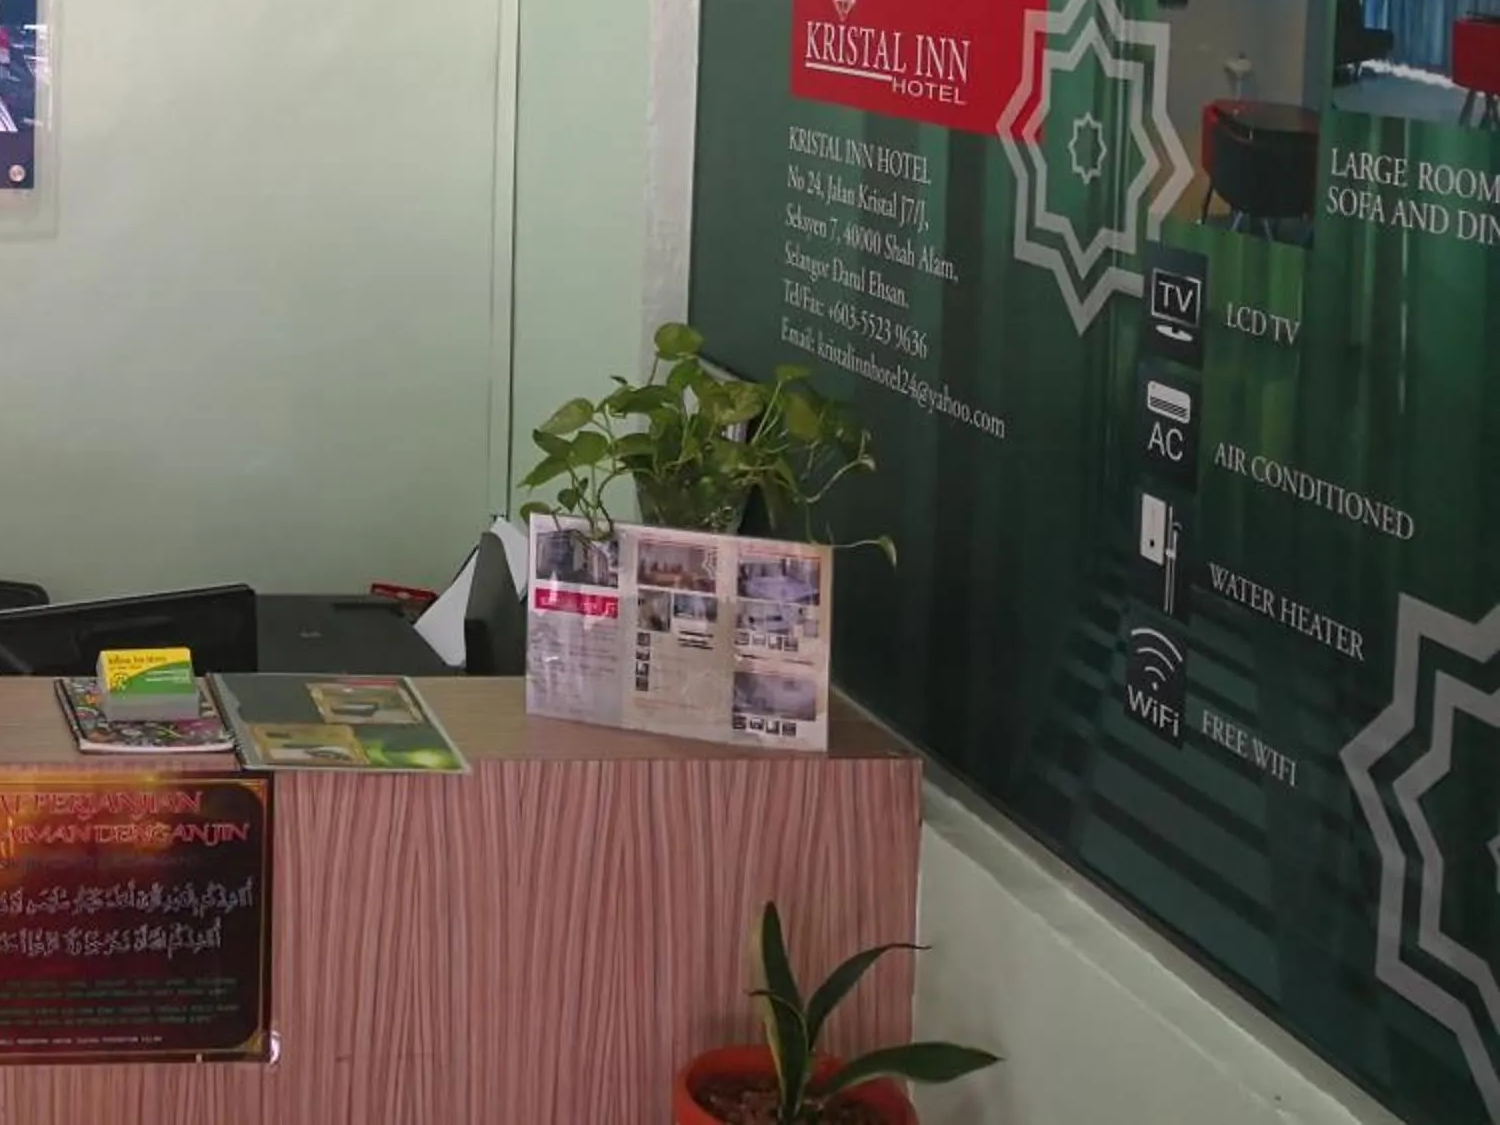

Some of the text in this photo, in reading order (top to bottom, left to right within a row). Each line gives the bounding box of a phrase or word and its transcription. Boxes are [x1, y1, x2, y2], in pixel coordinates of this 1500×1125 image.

[805, 21, 971, 83] KRISTAL INN
[892, 77, 967, 105] HOTEL
[789, 126, 843, 163] KRISTAL
[845, 139, 875, 169] INN
[1330, 148, 1408, 187] LARGE
[787, 164, 805, 190] No
[826, 174, 856, 206] Jalan
[858, 183, 897, 219] Kristal
[1326, 186, 1385, 225] SOFA
[1391, 199, 1450, 236] AND
[784, 240, 830, 283] Selangor
[832, 257, 865, 293] Darul
[883, 233, 915, 267] Shah
[1158, 279, 1194, 314] TV
[780, 316, 815, 355] Email:
[895, 323, 928, 360] 9636
[1226, 302, 1301, 346] LCD TV
[1147, 421, 1183, 461] AC
[1214, 442, 1414, 540] AIR CONDITIONED
[1209, 562, 1365, 662] WATER HEATER
[1127, 684, 1181, 737] WiFi
[1202, 709, 1297, 788] FREE WIFI
